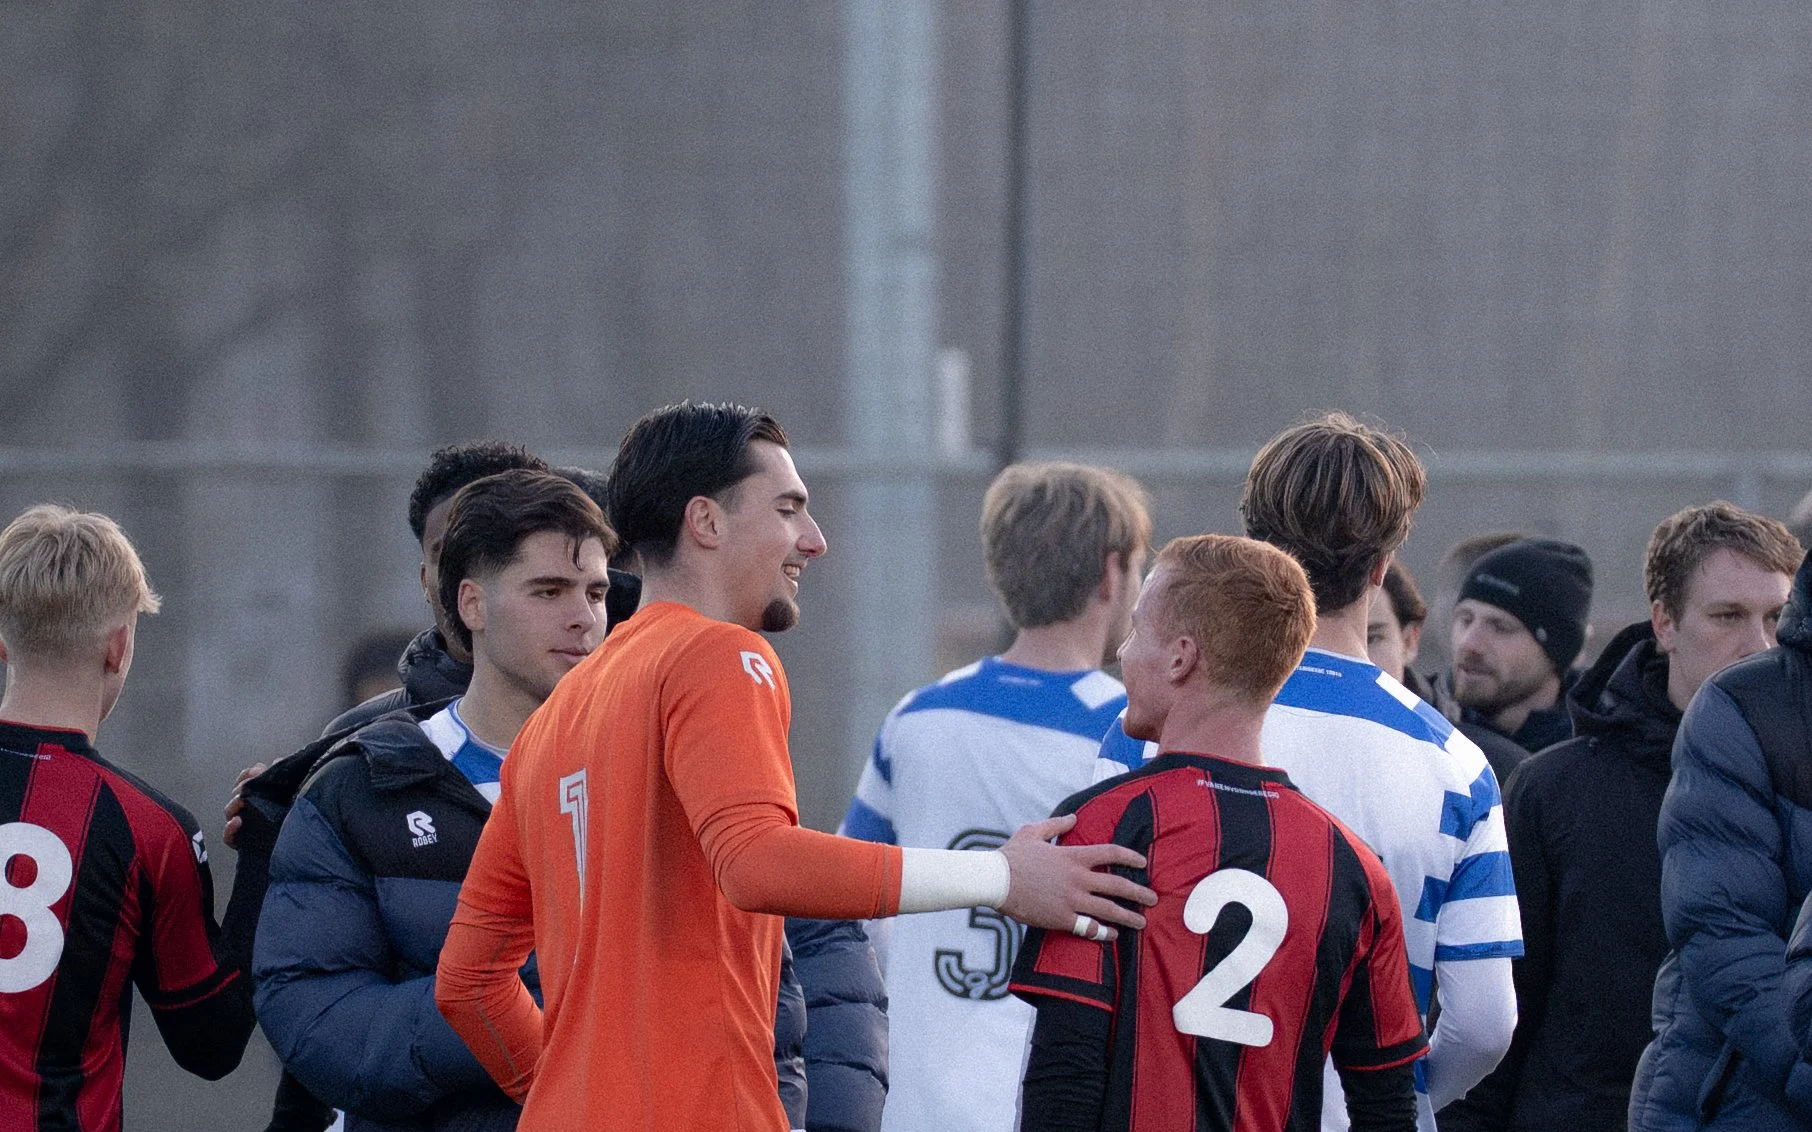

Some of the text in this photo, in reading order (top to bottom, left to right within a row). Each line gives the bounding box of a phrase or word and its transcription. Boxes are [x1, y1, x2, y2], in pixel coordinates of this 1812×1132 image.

[0, 821, 73, 994] 8
[412, 833, 438, 848] ROBEY
[559, 768, 589, 917] 1
[1173, 868, 1289, 1047] 2
